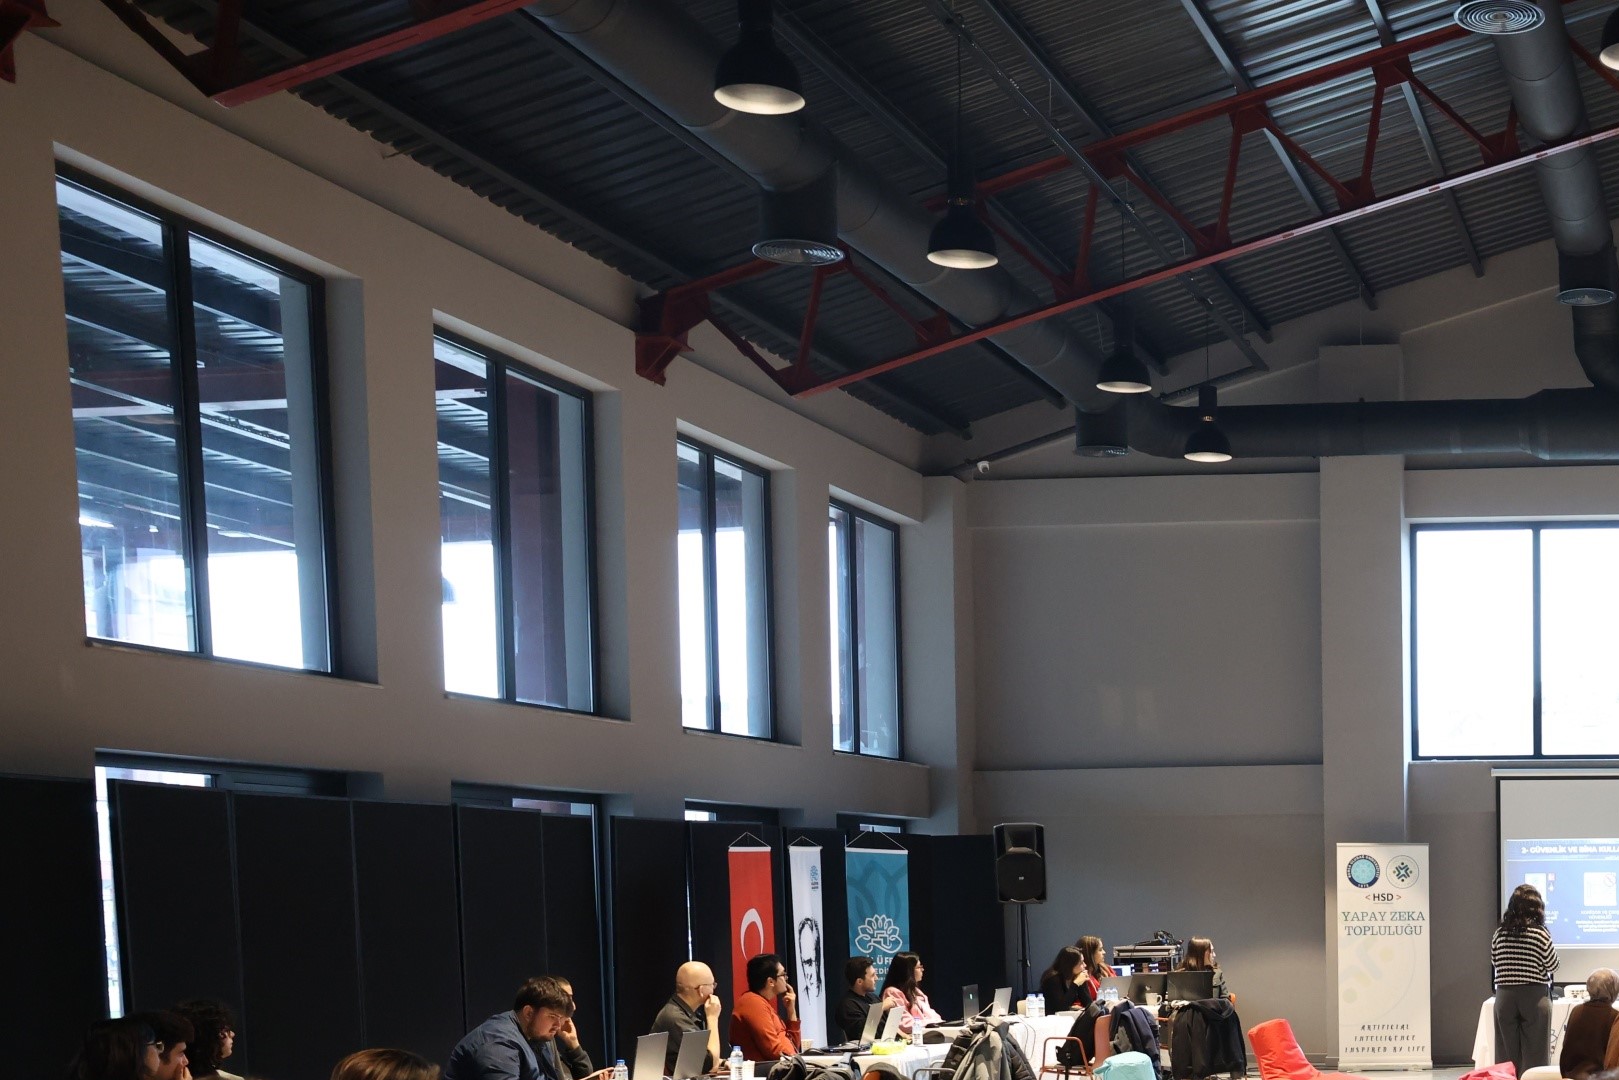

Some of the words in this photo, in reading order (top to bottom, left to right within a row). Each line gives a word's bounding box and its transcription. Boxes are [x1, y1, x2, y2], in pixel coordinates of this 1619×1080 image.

[1342, 911, 1387, 921] YAPAY
[1390, 911, 1425, 921] ZEKA
[1344, 923, 1423, 936] TOPLULUĞU
[1354, 1034, 1415, 1042] INTELLIGENCE
